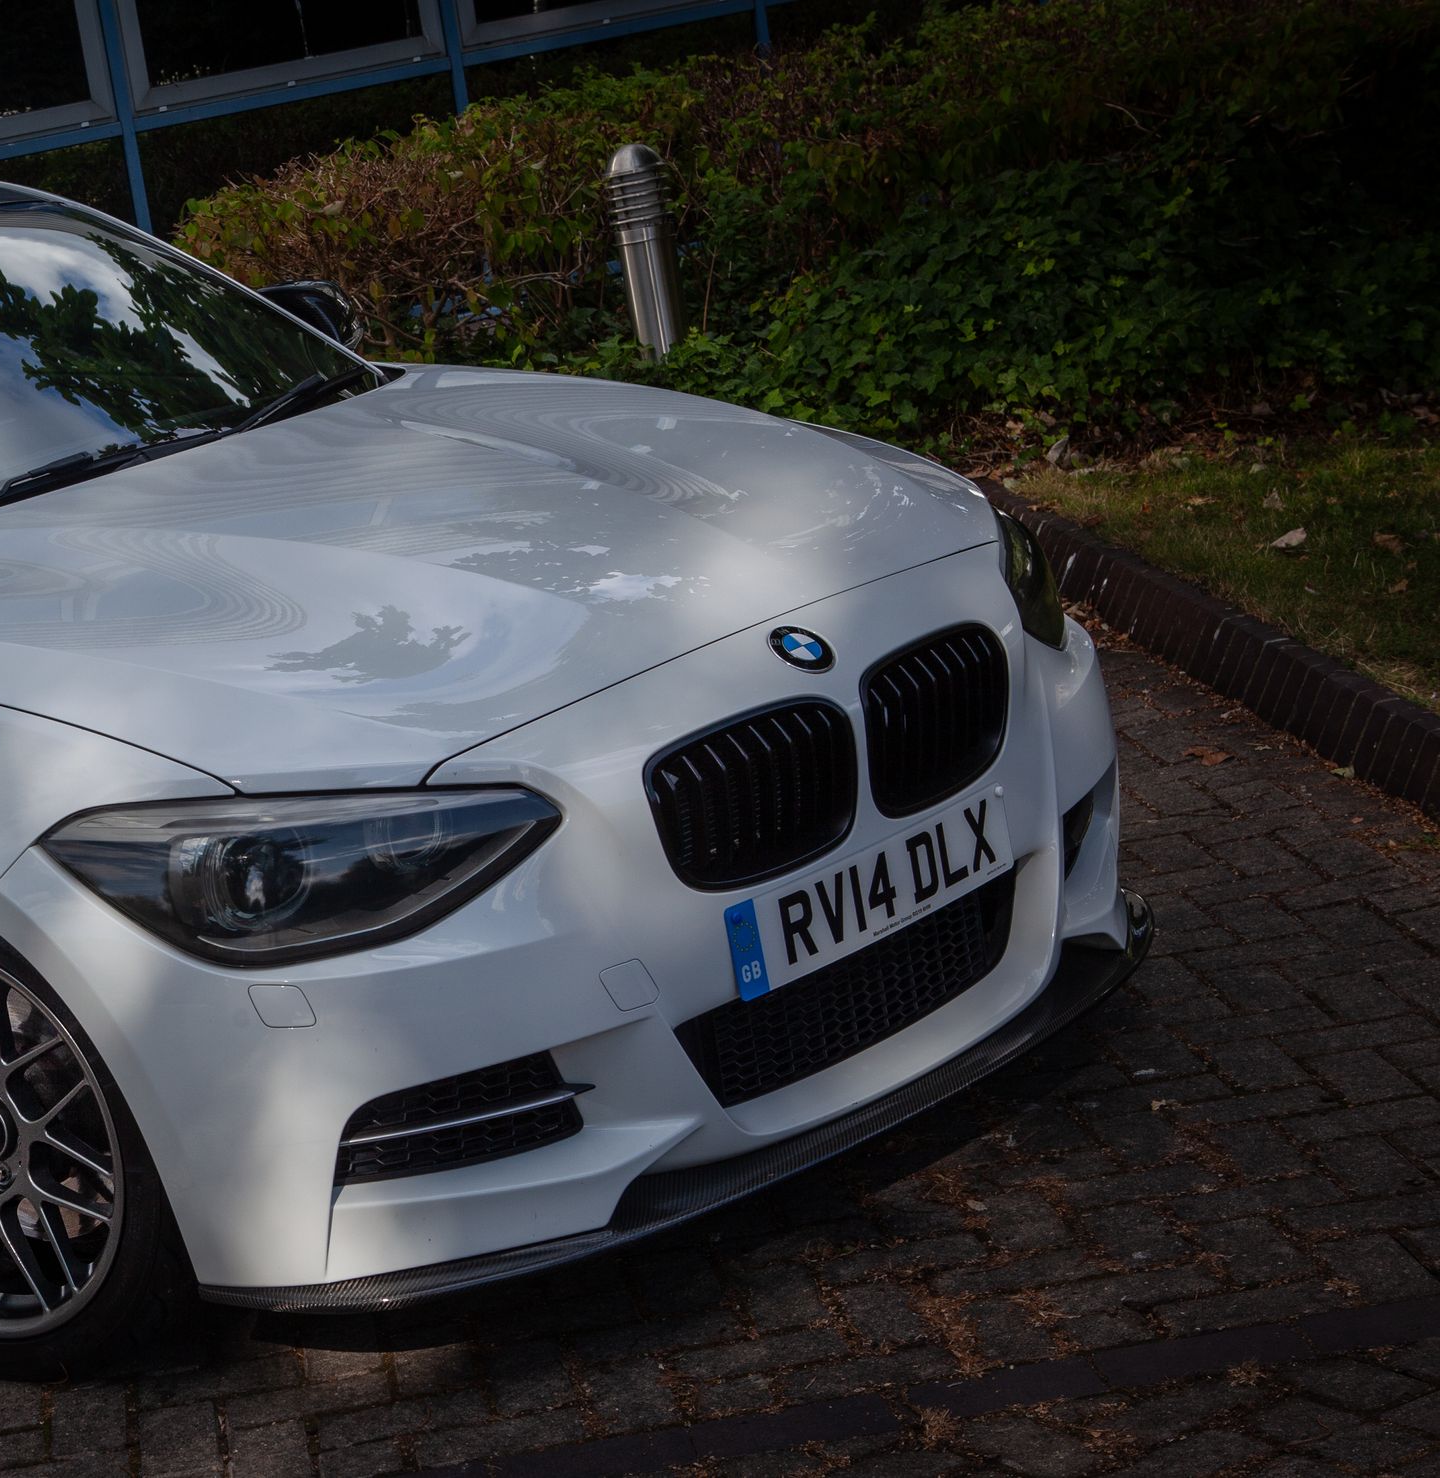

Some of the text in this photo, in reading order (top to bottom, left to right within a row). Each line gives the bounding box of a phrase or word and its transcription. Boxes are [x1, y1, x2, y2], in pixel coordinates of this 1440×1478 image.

[777, 798, 997, 967] RV14 DLX
[741, 959, 762, 984] GB
